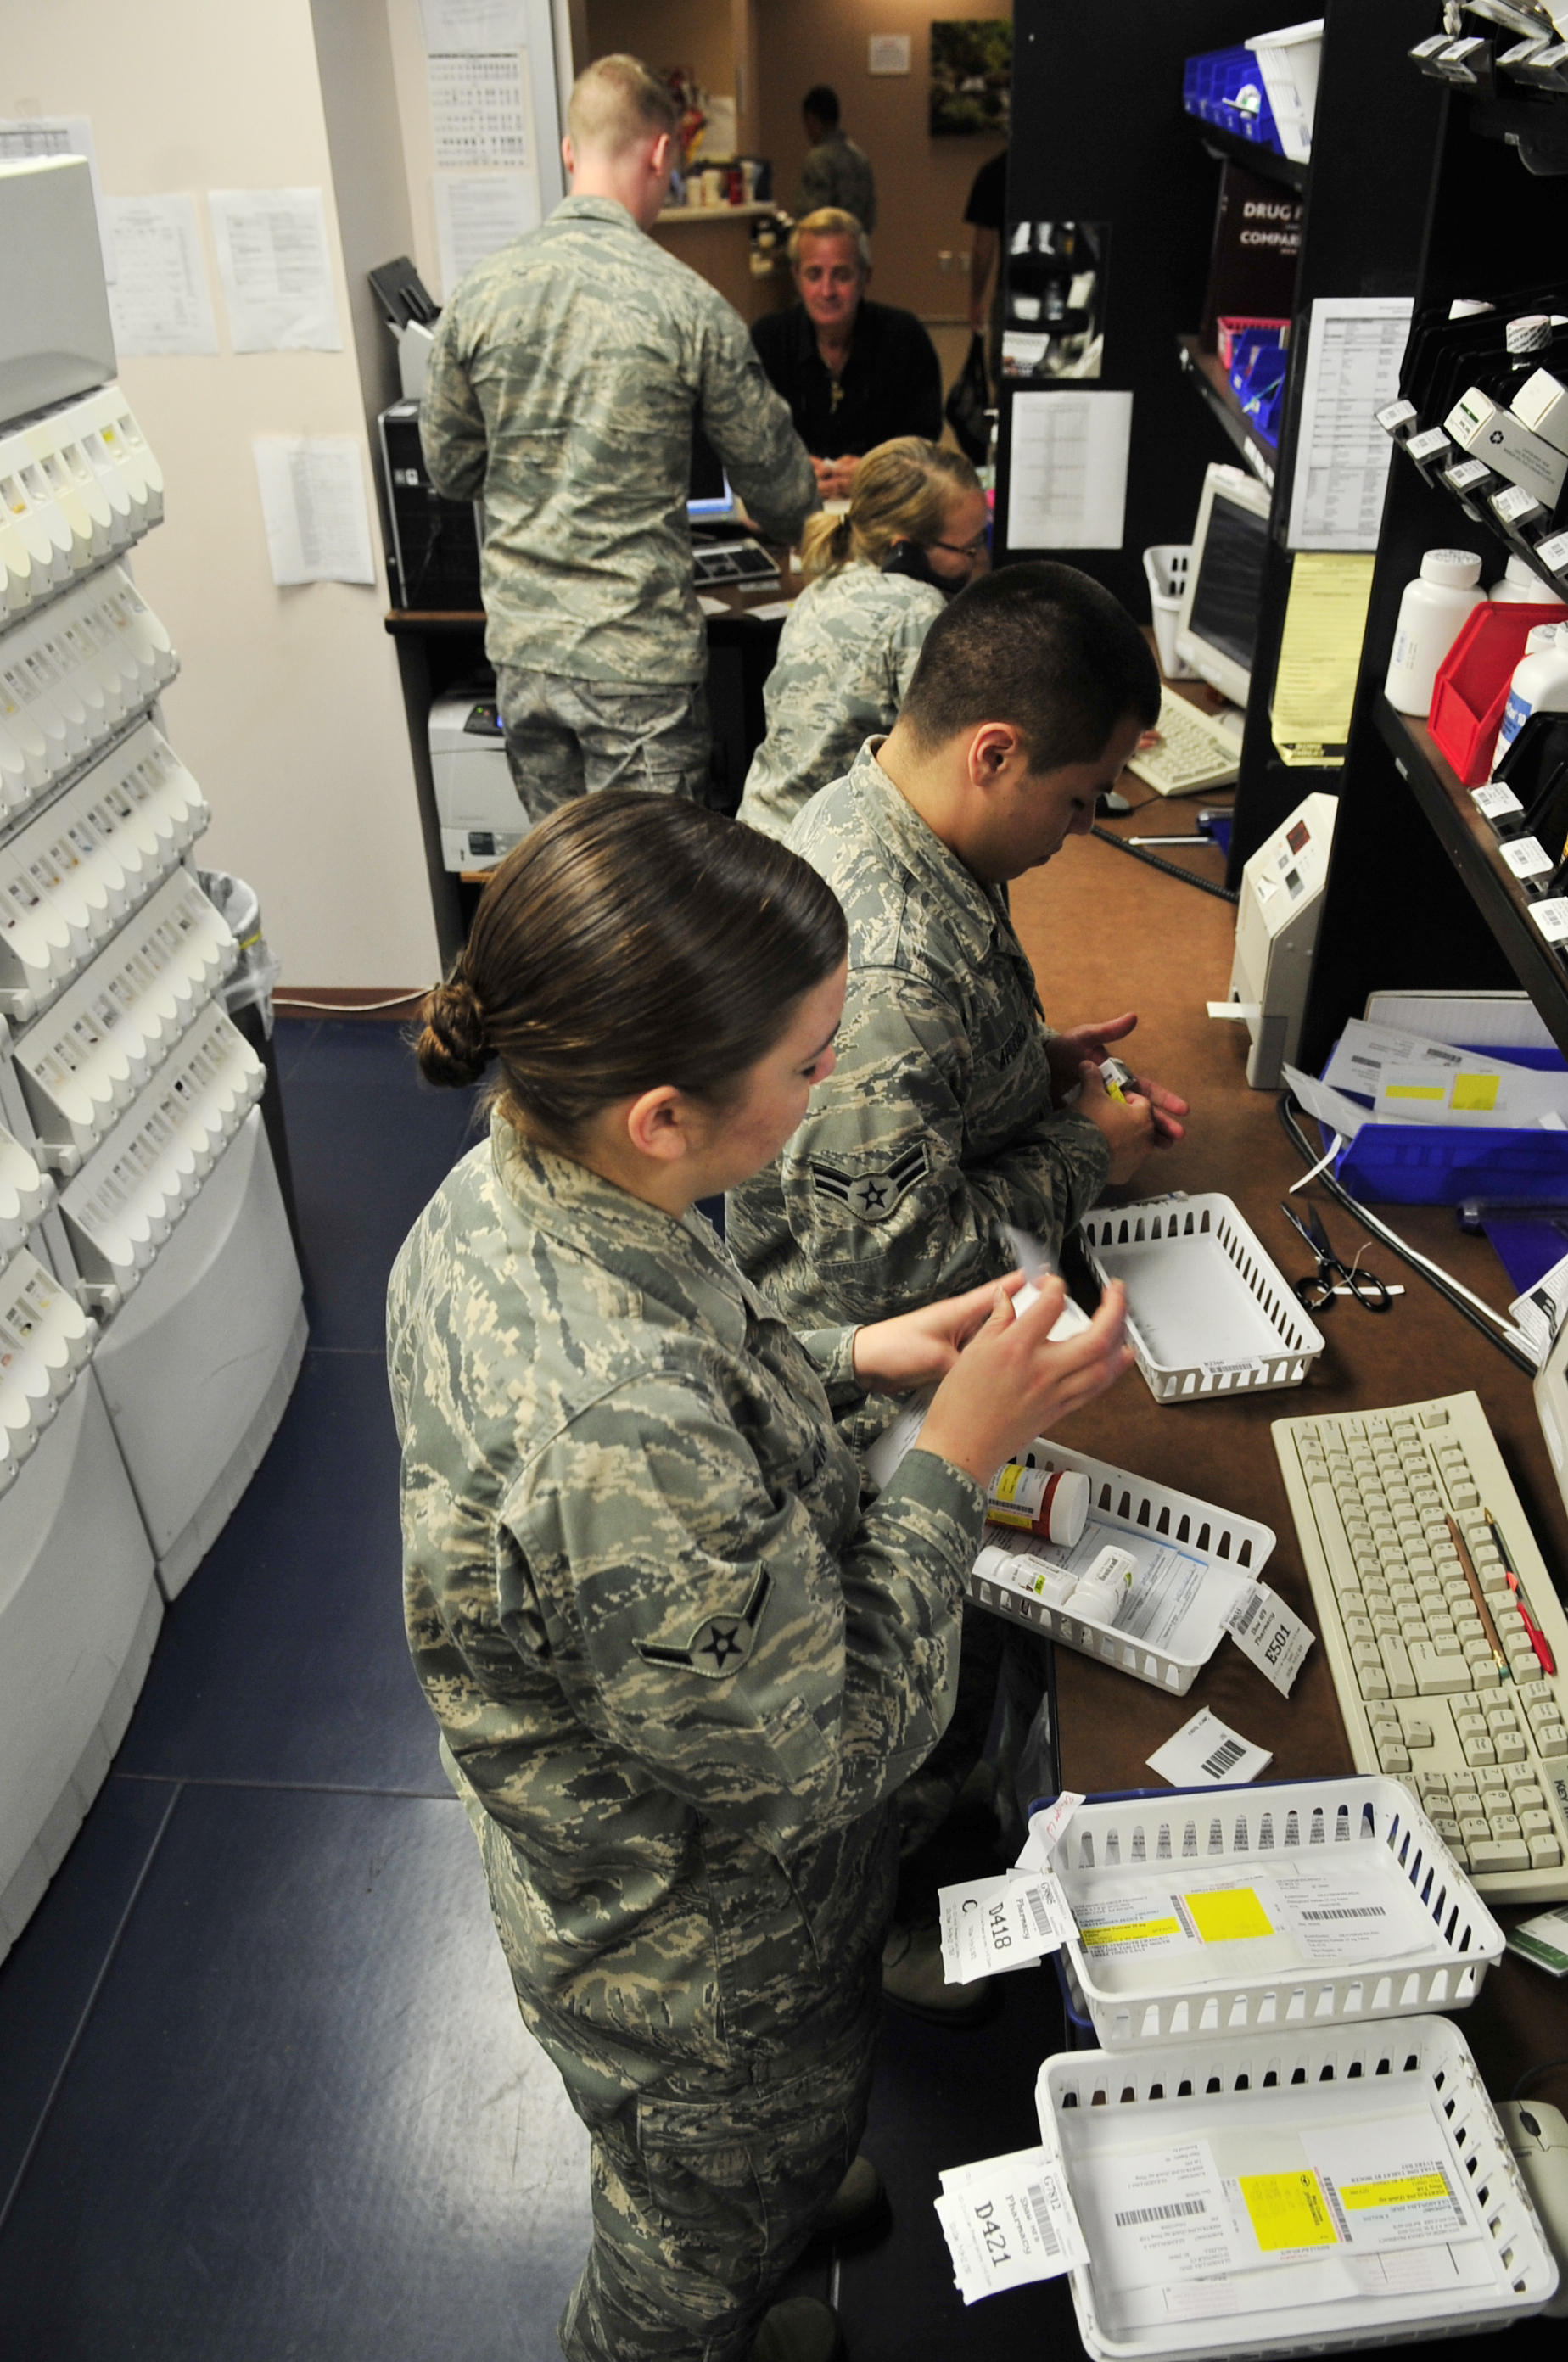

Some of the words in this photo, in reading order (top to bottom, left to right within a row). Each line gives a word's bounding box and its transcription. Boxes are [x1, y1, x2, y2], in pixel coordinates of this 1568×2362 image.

[1243, 201, 1291, 221] DRUG
[1255, 1612, 1276, 1646] Pharmacy
[1264, 1624, 1291, 1665] E501
[961, 1899, 978, 1913] C
[1016, 1898, 1030, 1939] Pharmacy
[988, 1901, 1012, 1951] D418
[1020, 2197, 1032, 2221] Shaw
[1044, 2174, 1061, 2211] G7812
[974, 2200, 1011, 2268] D421
[1005, 2194, 1032, 2255] Pharmacy
